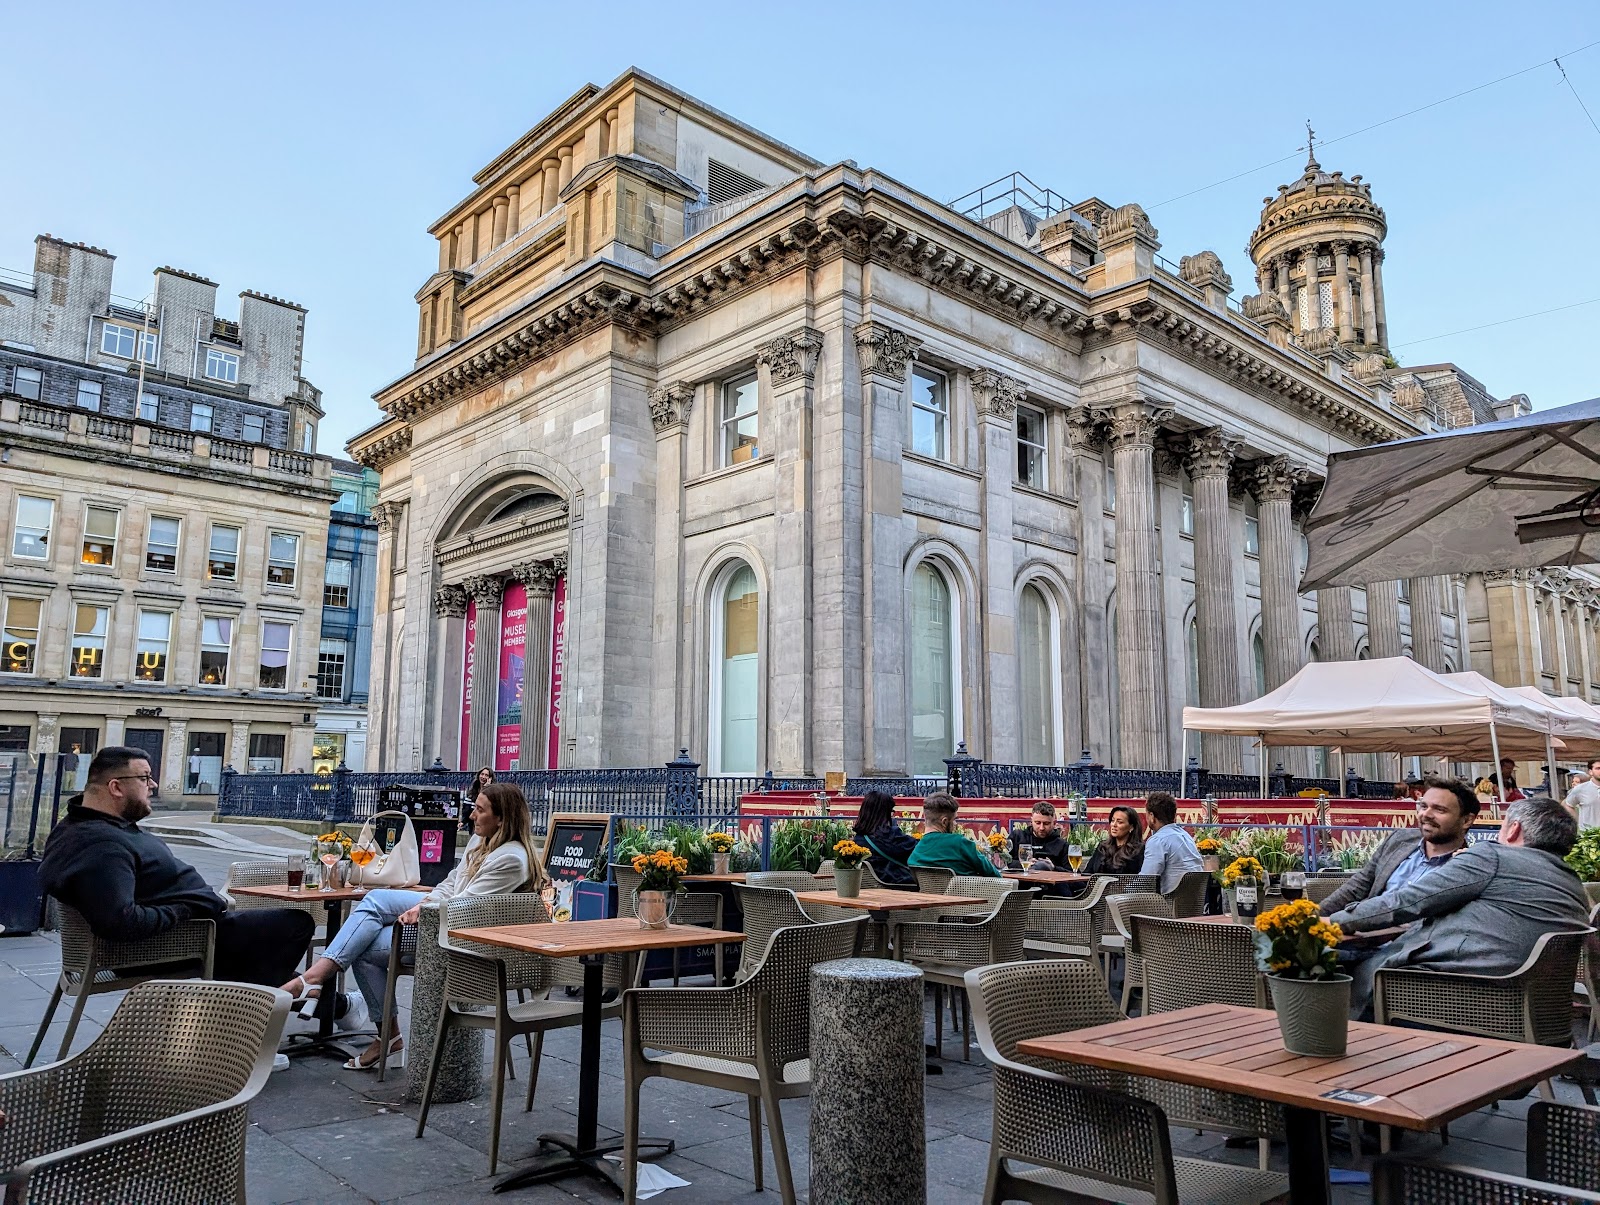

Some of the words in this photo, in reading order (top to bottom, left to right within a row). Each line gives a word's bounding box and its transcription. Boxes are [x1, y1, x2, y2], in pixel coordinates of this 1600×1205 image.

[504, 623, 526, 637] MUSEU
[504, 637, 526, 647] MEMBER
[564, 846, 583, 856] FOOD
[550, 856, 573, 868] SERVED
[573, 858, 592, 868] DAILY
[696, 947, 716, 957] SMA
[725, 944, 742, 954] PLAT
